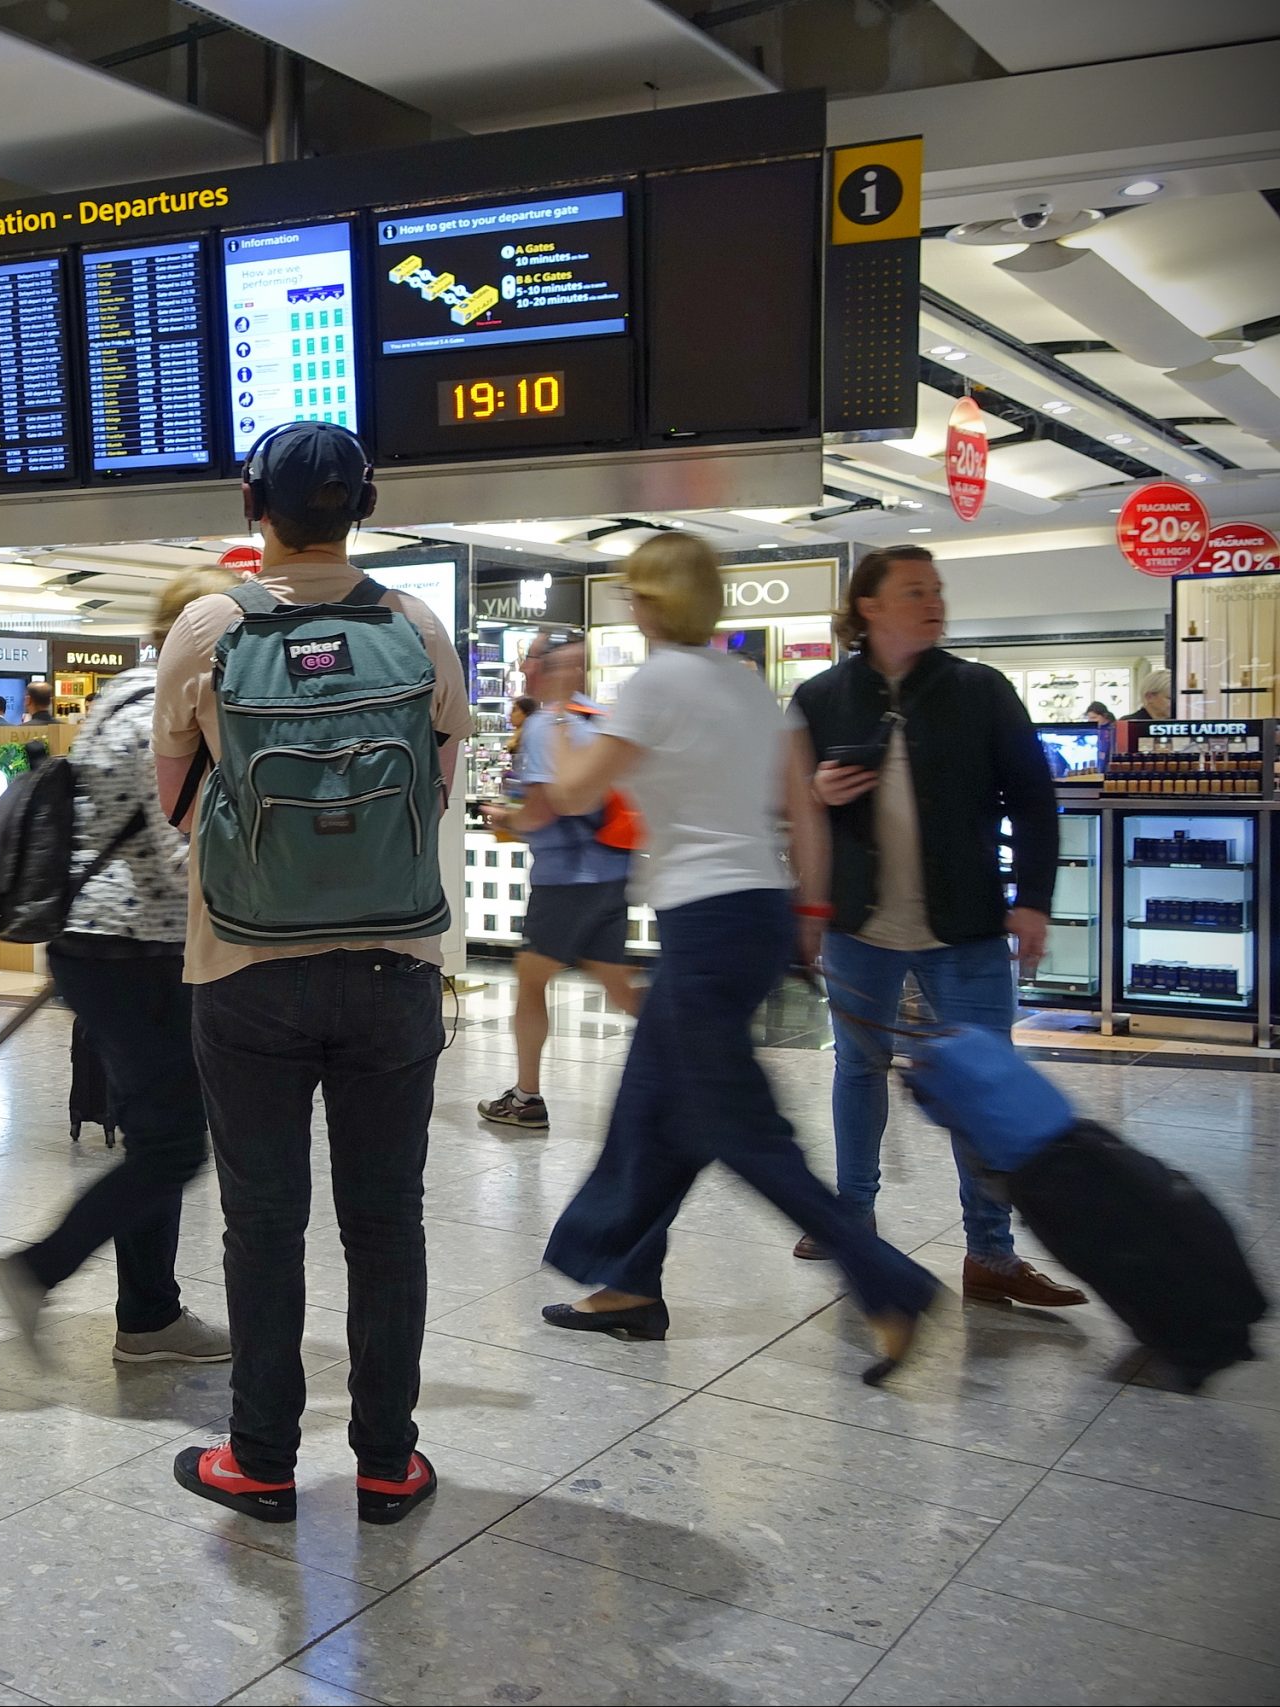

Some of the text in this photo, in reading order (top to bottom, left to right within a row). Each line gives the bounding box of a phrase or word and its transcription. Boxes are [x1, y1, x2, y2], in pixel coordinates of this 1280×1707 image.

[78, 186, 228, 226] Departures
[399, 204, 579, 235] How to get to your departure gate
[241, 234, 300, 249] Information
[515, 243, 555, 255] A Gates
[515, 256, 528, 267] 10
[529, 253, 570, 265] minutes
[242, 265, 300, 279] How are we
[516, 271, 572, 284] B & C Gates
[242, 274, 303, 290] performing?
[516, 285, 540, 296] 5-10
[541, 282, 582, 294] minutes
[516, 297, 546, 308] 10-20
[547, 293, 588, 305] minutes
[453, 376, 560, 419] 19:10
[950, 441, 984, 479] -20%
[1136, 503, 1191, 512] FRAGRANCE
[1127, 516, 1201, 543] -20%
[1209, 537, 1265, 547] FRAGRANCE
[1152, 547, 1165, 556] UK
[1166, 547, 1191, 555] HIGH
[1198, 549, 1275, 573] -20%
[289, 641, 342, 658] poker
[66, 652, 123, 665] BVLGARI
[304, 655, 332, 668] GO
[1149, 723, 1247, 736] ESTEE LAUDER
